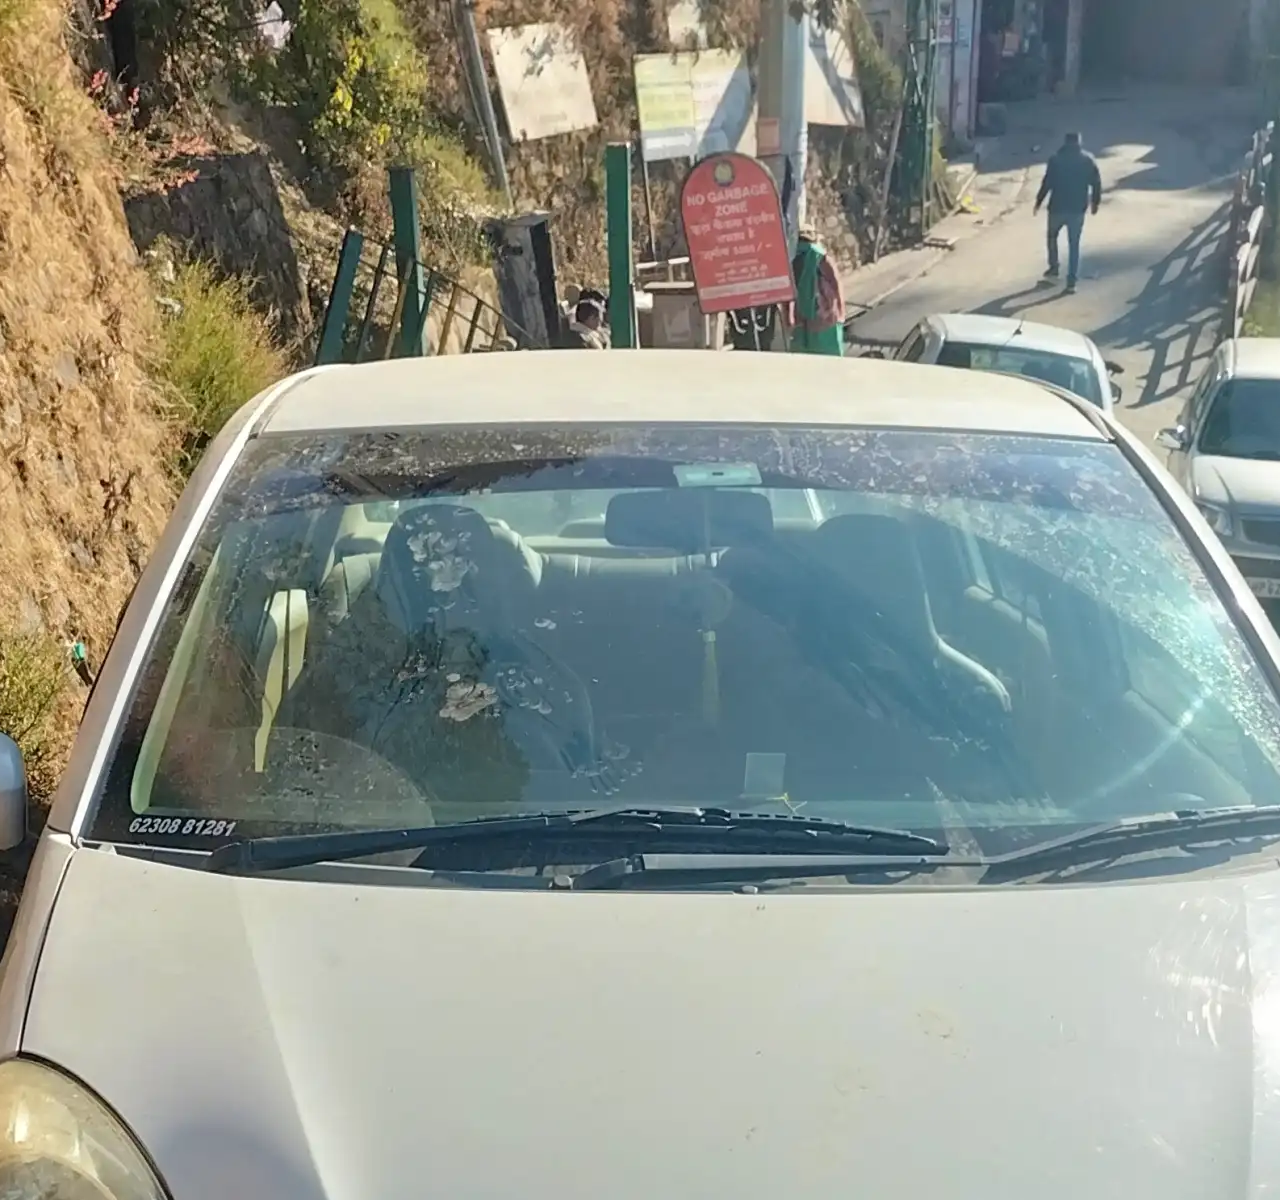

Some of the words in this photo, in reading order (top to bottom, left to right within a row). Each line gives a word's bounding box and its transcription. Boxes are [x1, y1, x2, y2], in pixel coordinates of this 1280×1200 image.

[687, 194, 705, 207] NO
[707, 183, 769, 202] GARBAGE
[715, 201, 748, 216] ZONE
[128, 817, 182, 834] 62308
[181, 819, 237, 837] 81281
